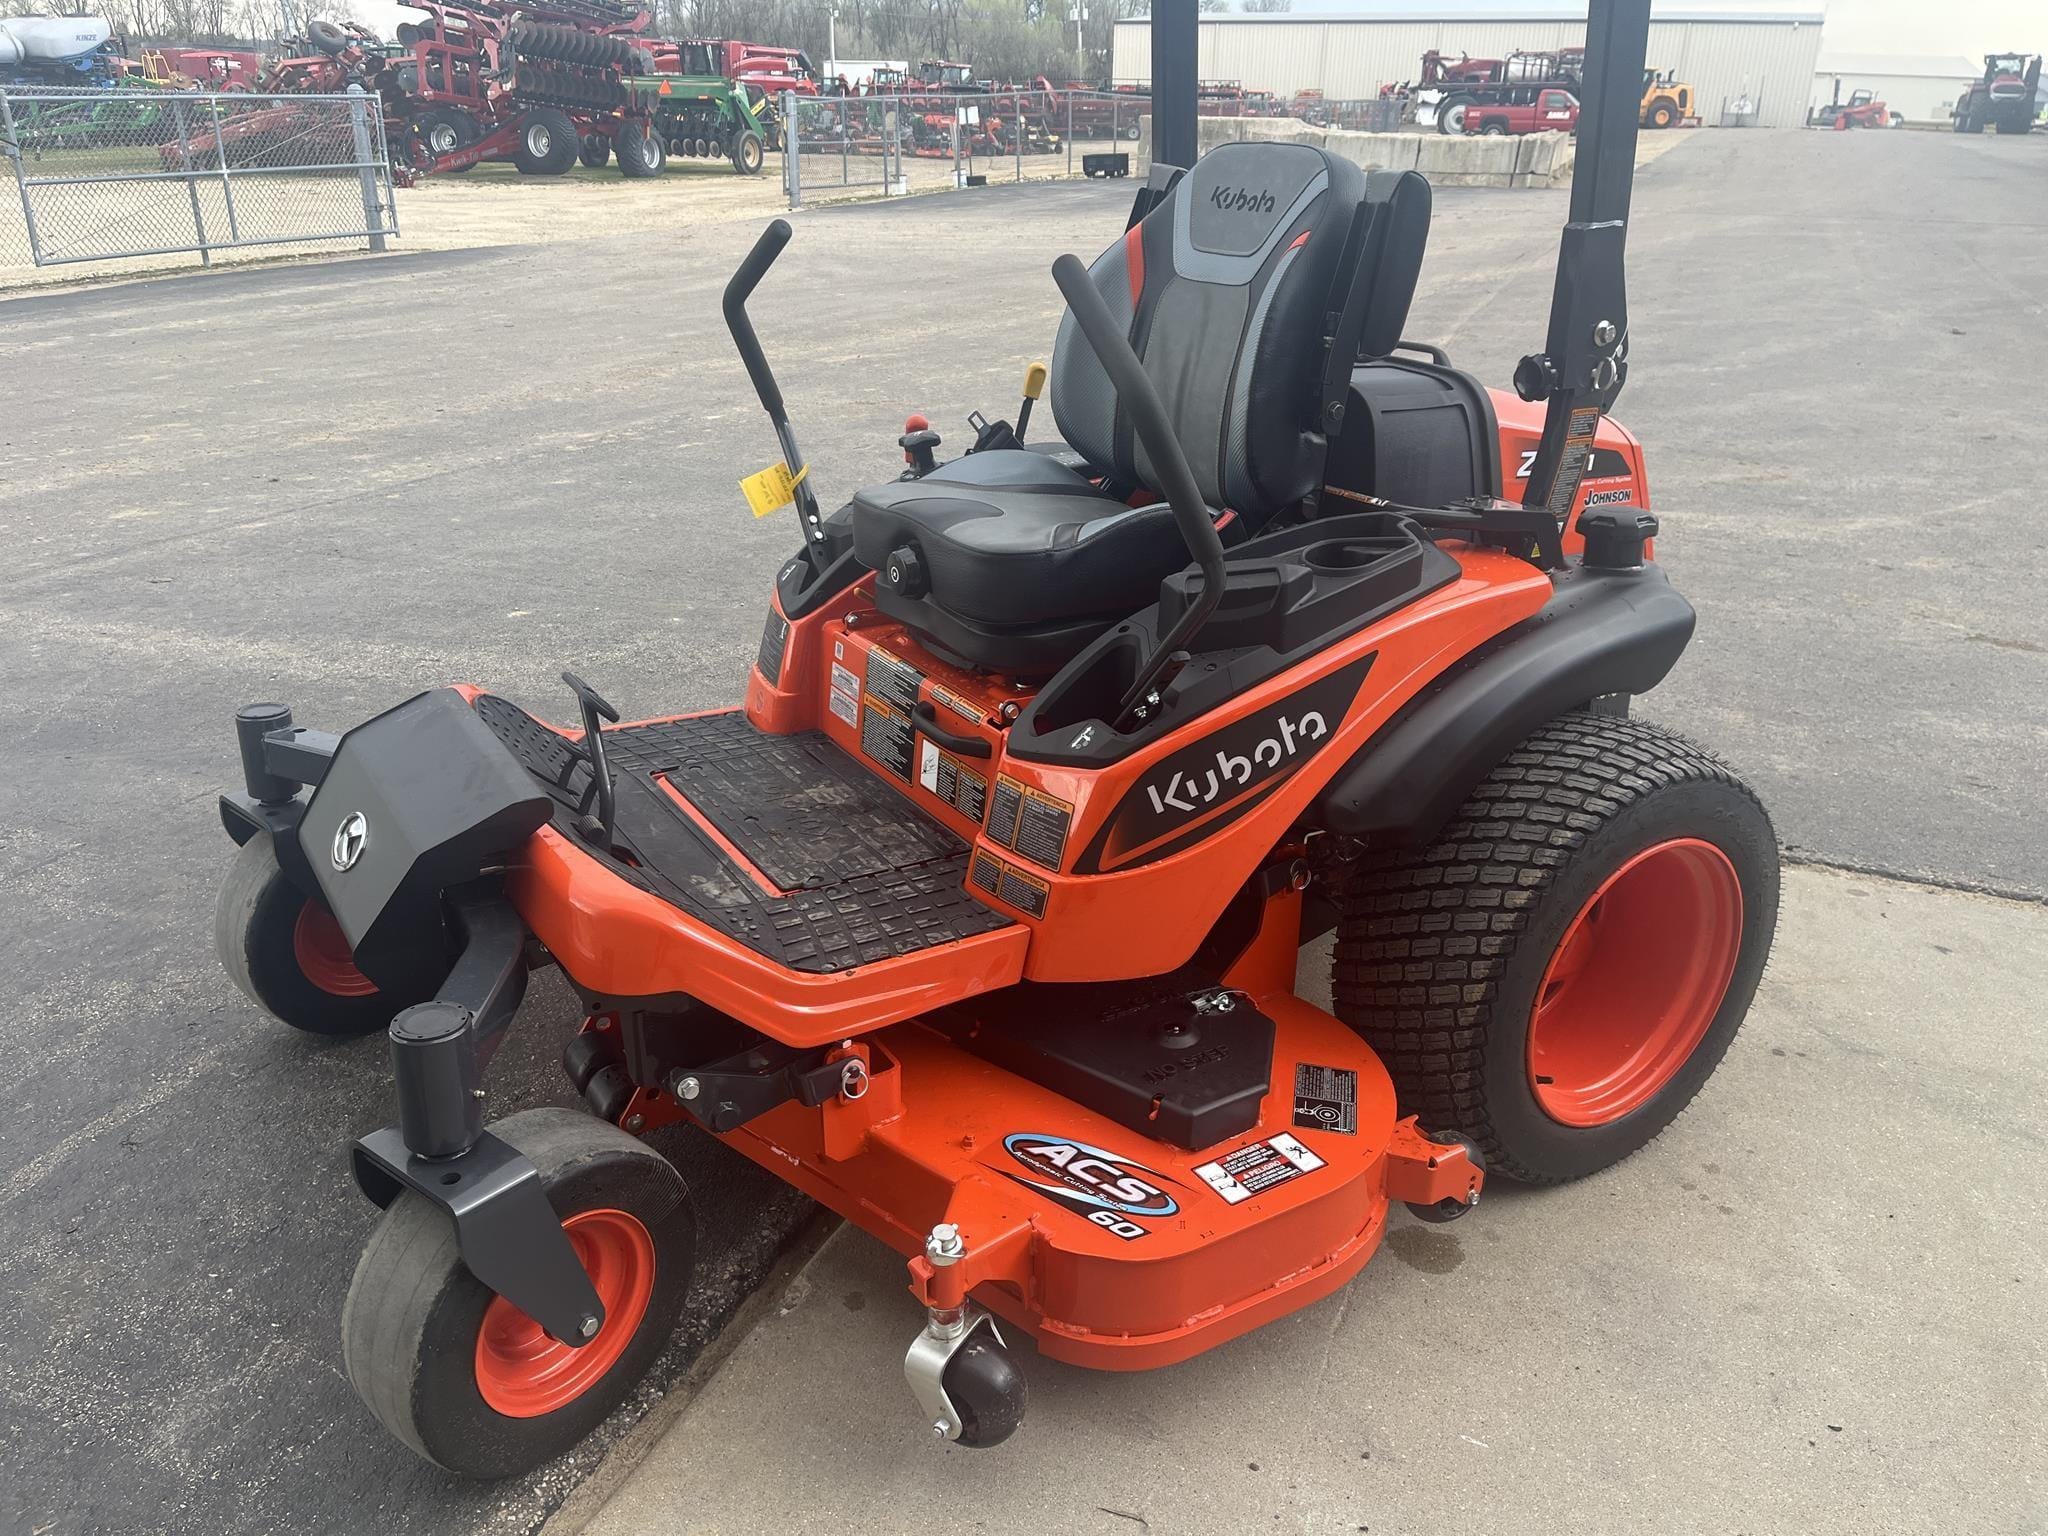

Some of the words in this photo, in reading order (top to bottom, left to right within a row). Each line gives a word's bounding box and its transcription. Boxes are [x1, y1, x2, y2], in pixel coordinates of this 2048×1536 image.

[1210, 186, 1276, 213] Kubota
[1583, 489, 1632, 506] JOHNSON
[1147, 711, 1327, 814] Kubota
[1231, 1144, 1262, 1160] DANGER
[1023, 1144, 1161, 1203] ACS
[1063, 1176, 1096, 1194] Cutting
[1088, 1211, 1144, 1238] 60
